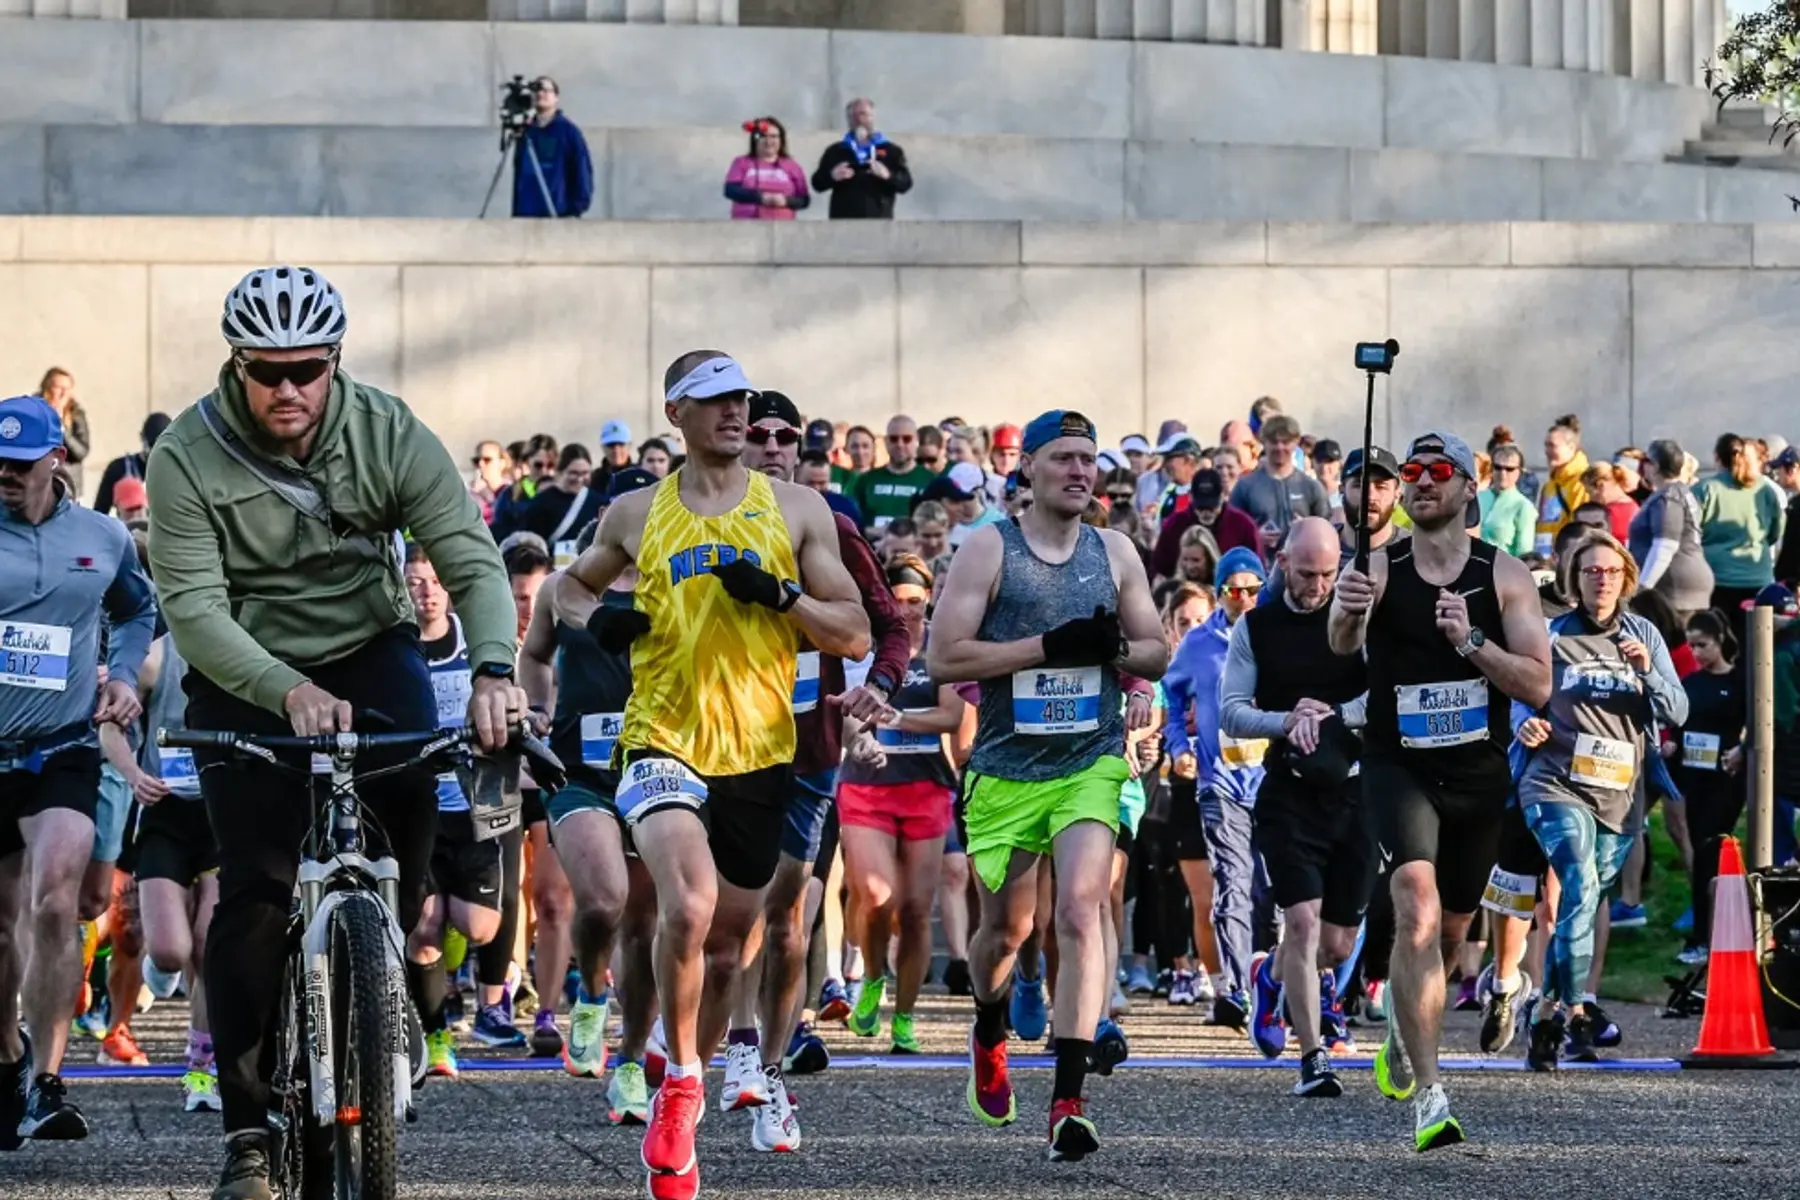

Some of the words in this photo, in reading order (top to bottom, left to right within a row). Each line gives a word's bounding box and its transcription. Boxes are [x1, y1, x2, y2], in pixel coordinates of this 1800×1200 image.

[7, 651, 40, 676] 512
[1043, 699, 1076, 721] 463
[1428, 711, 1462, 734] 536
[642, 776, 680, 798] 548
